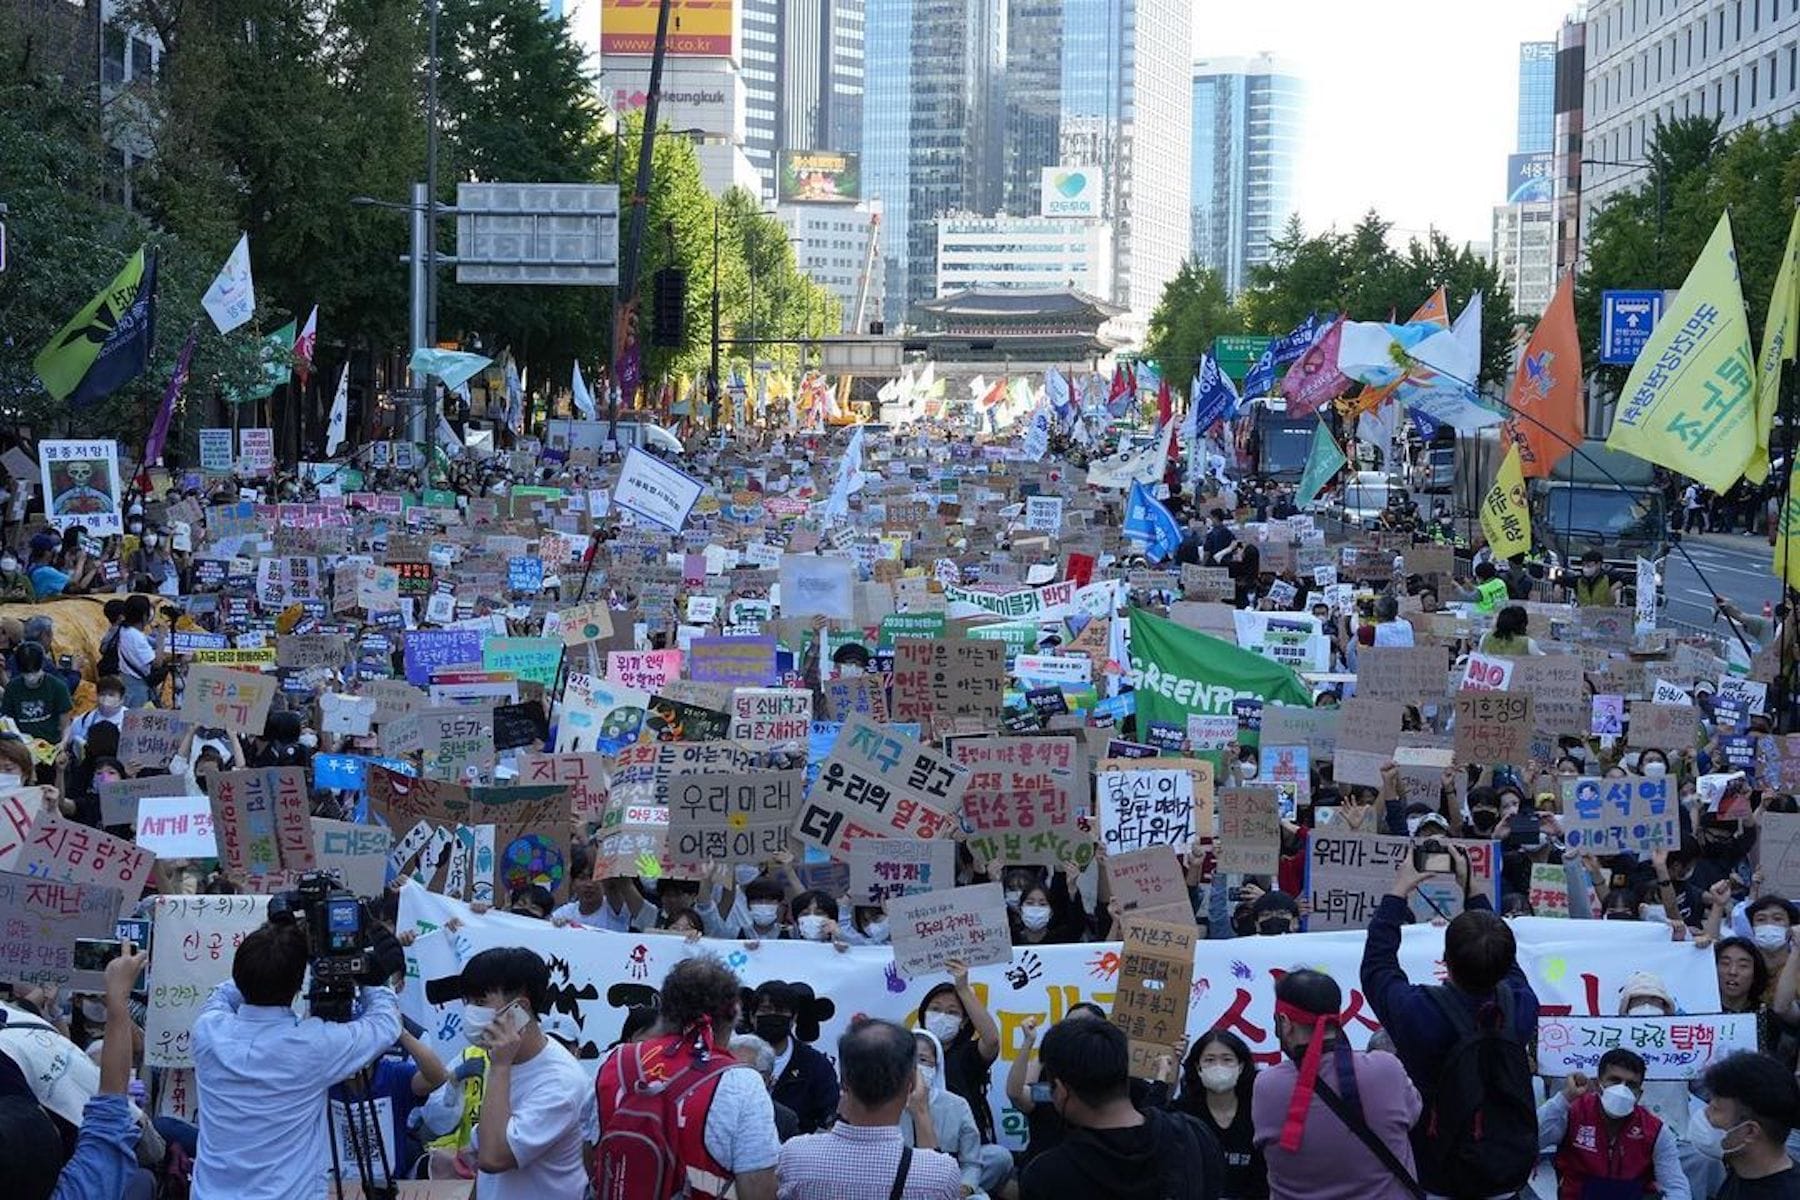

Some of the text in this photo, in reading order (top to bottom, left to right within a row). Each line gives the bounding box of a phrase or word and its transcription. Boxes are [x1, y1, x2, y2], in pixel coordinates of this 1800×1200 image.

[1050, 202, 1090, 212] 모두투어
[1501, 514, 1524, 542] 세상
[1470, 659, 1505, 686] NO
[757, 695, 808, 716] 소비하고
[1462, 697, 1528, 722] 기후정의
[736, 724, 750, 740] 더
[754, 720, 808, 741] 존재하라
[532, 757, 589, 781] 지구
[849, 724, 956, 798] 지구 말고
[823, 763, 891, 814] 우리의
[1107, 774, 1178, 803] 당신이
[963, 789, 1067, 830] 탄소중립
[142, 814, 188, 837] 세계
[800, 804, 844, 847] 더
[1314, 838, 1367, 867] 우리가
[170, 897, 257, 918] 기후위기
[1313, 888, 1367, 924] 너희가
[1129, 926, 1190, 949] 자본주의
[1152, 1019, 1167, 1039] 수
[1581, 1025, 1622, 1048] 지금
[1632, 1023, 1666, 1048] 당장
